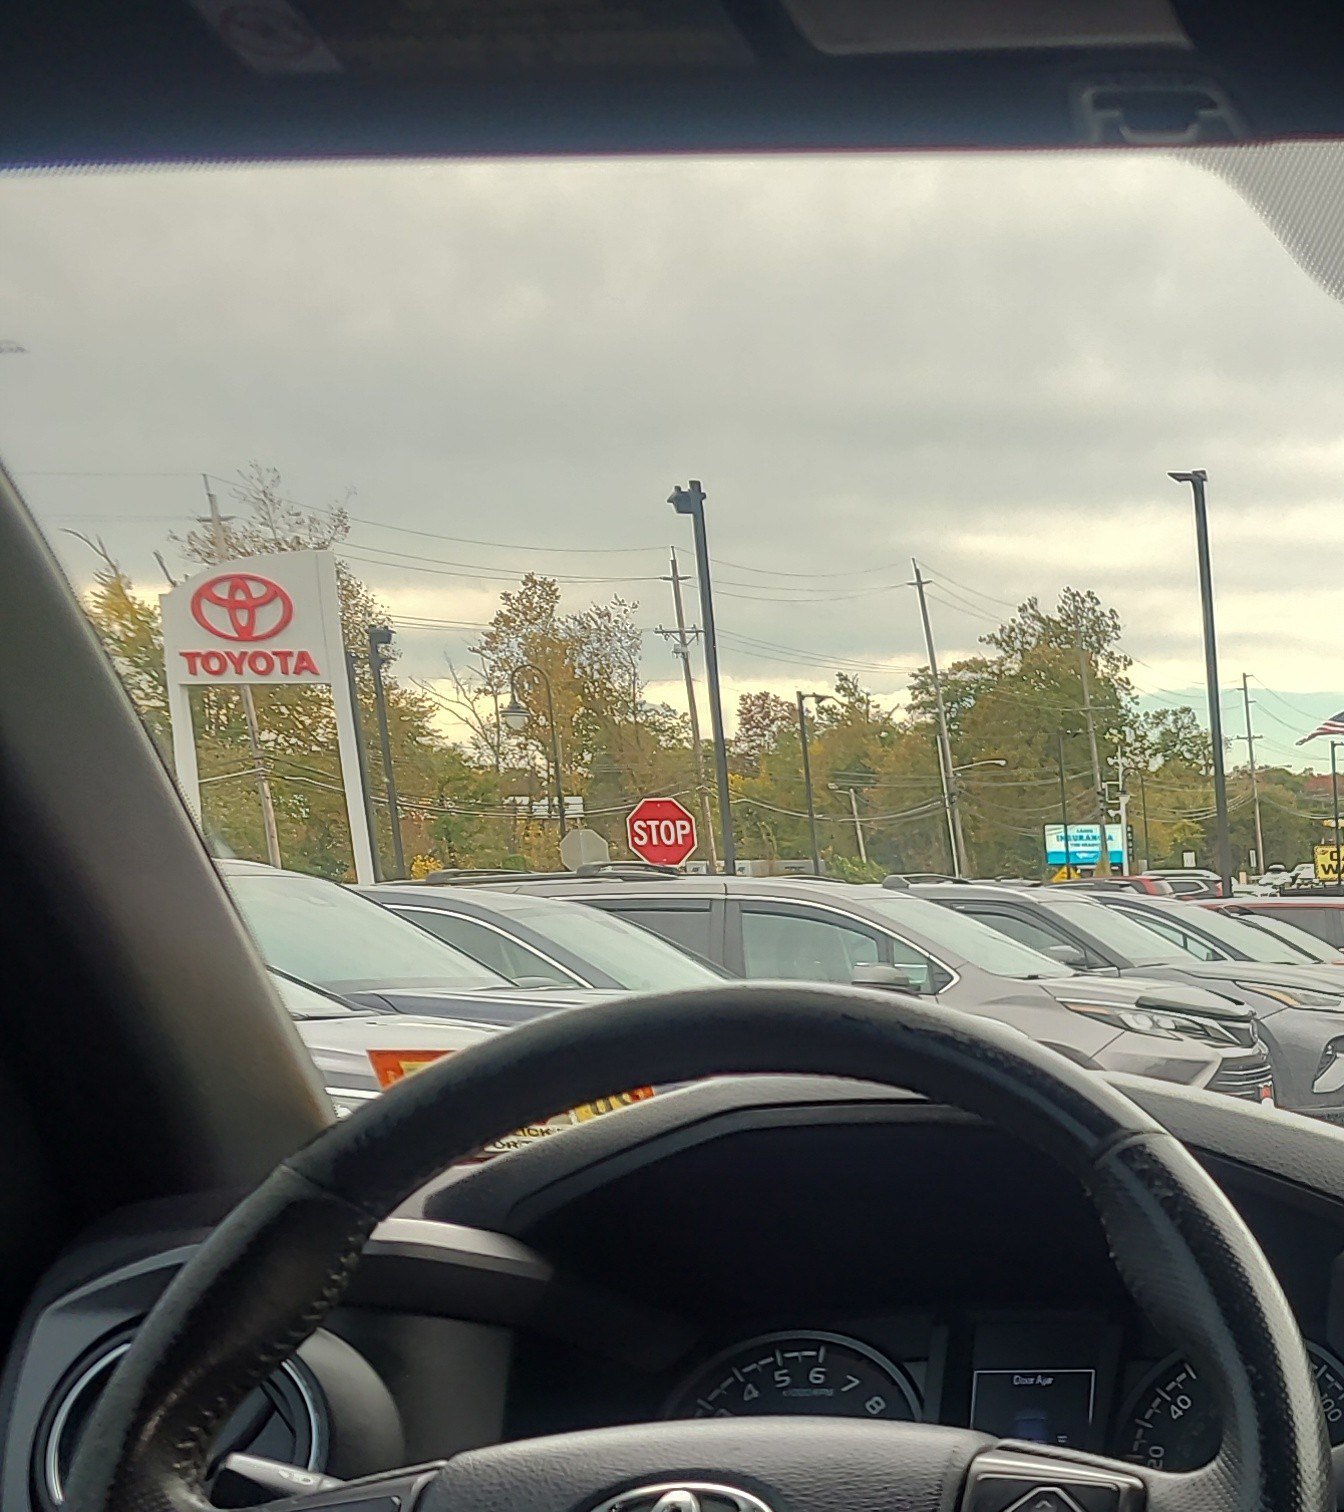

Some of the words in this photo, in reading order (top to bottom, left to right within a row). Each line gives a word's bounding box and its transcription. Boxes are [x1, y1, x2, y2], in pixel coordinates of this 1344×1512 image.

[179, 649, 320, 676] TOYOTA
[633, 820, 691, 846] STOP
[743, 1383, 759, 1401] 4
[774, 1368, 791, 1389] 5
[808, 1367, 827, 1385] 6
[841, 1374, 861, 1393] 7
[864, 1396, 886, 1416] 8
[1169, 1395, 1192, 1420] 40
